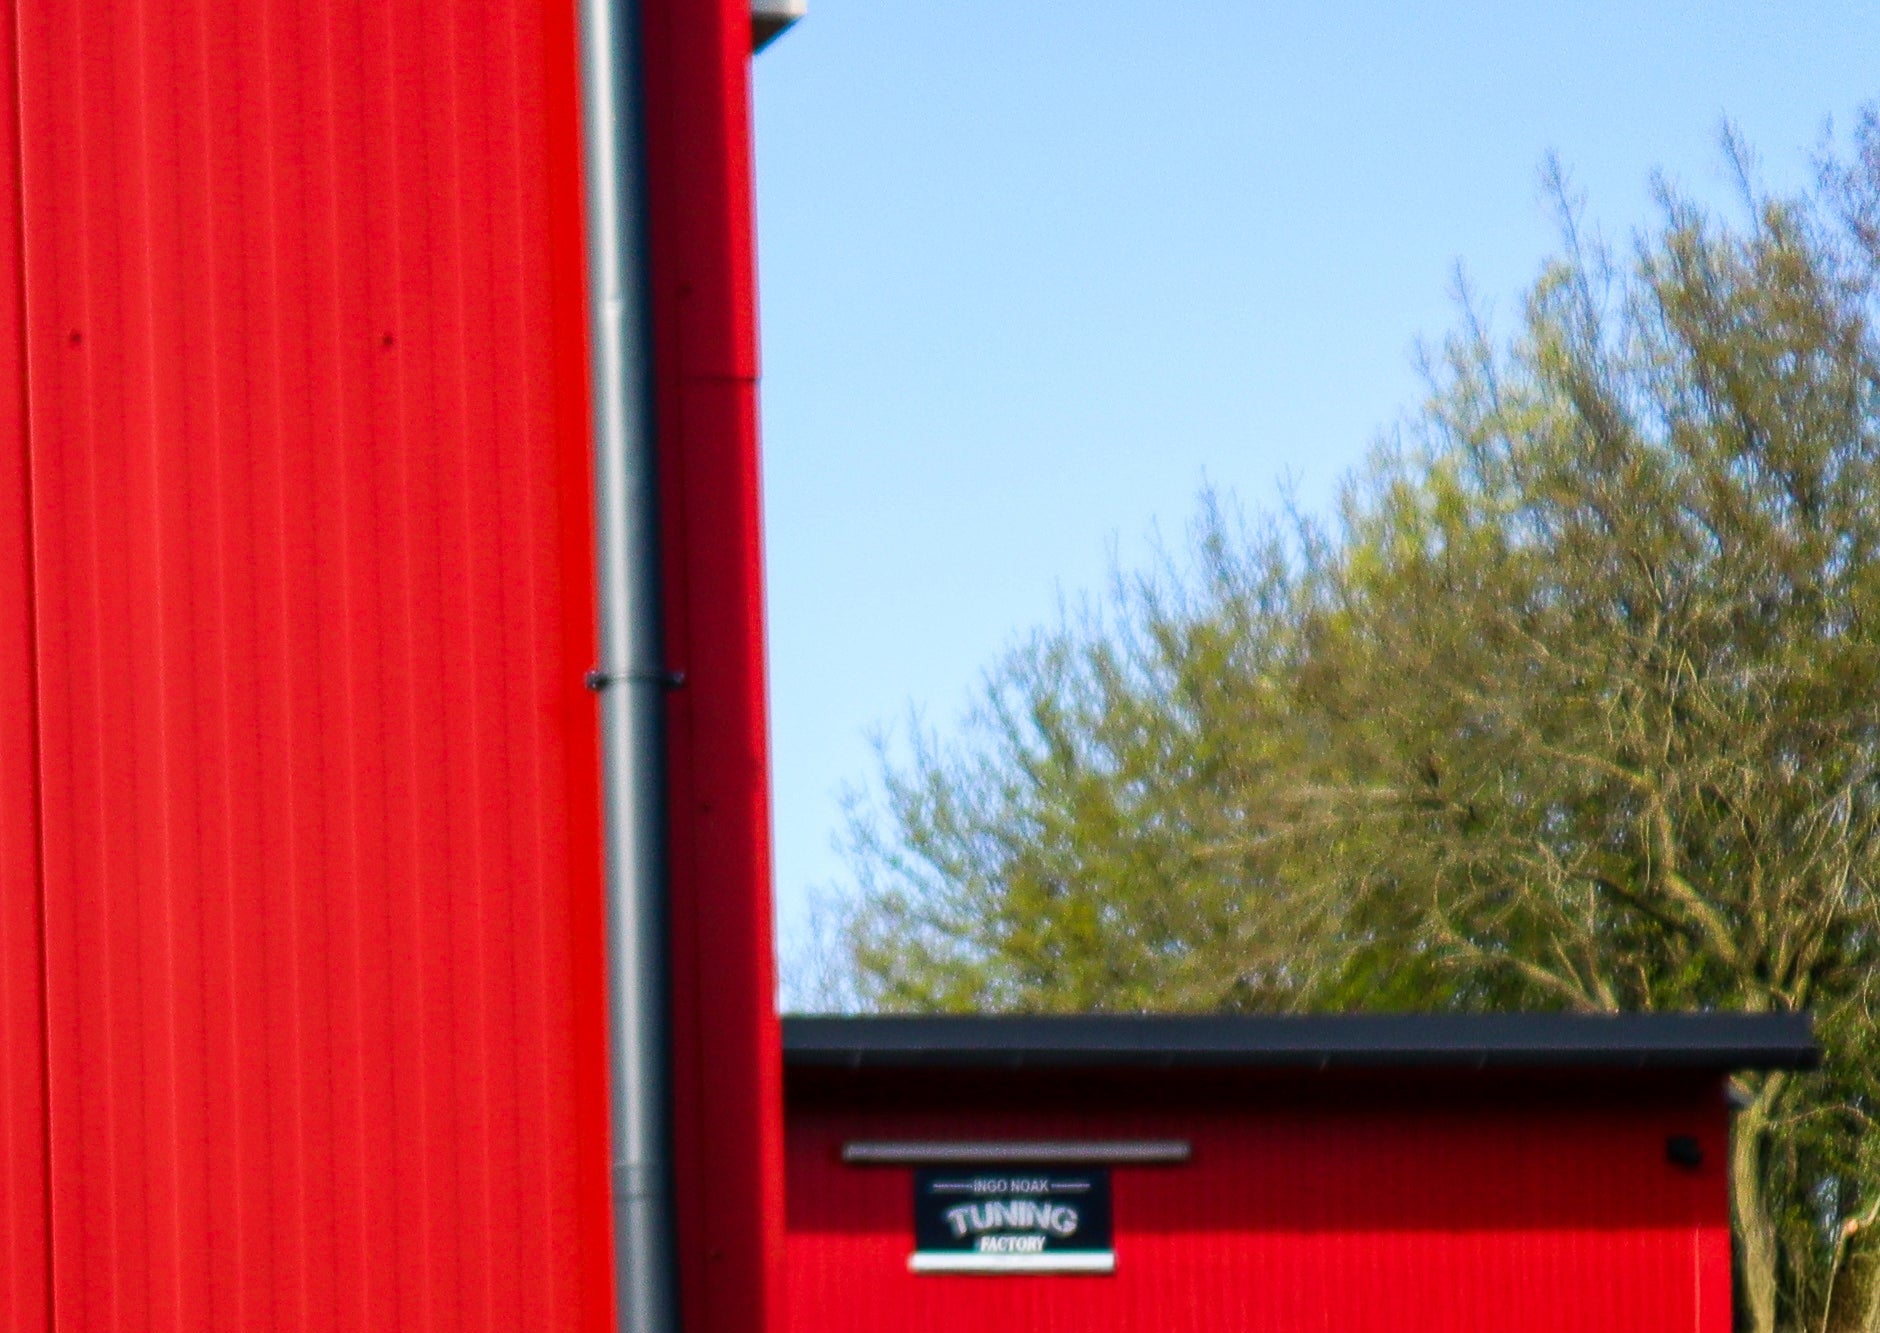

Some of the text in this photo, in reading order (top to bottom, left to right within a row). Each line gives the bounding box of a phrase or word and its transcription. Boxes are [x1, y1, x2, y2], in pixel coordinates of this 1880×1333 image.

[972, 1179, 1049, 1193] INGO NOAK
[946, 1200, 1079, 1236] TUNING
[979, 1235, 1046, 1252] FACTORY
